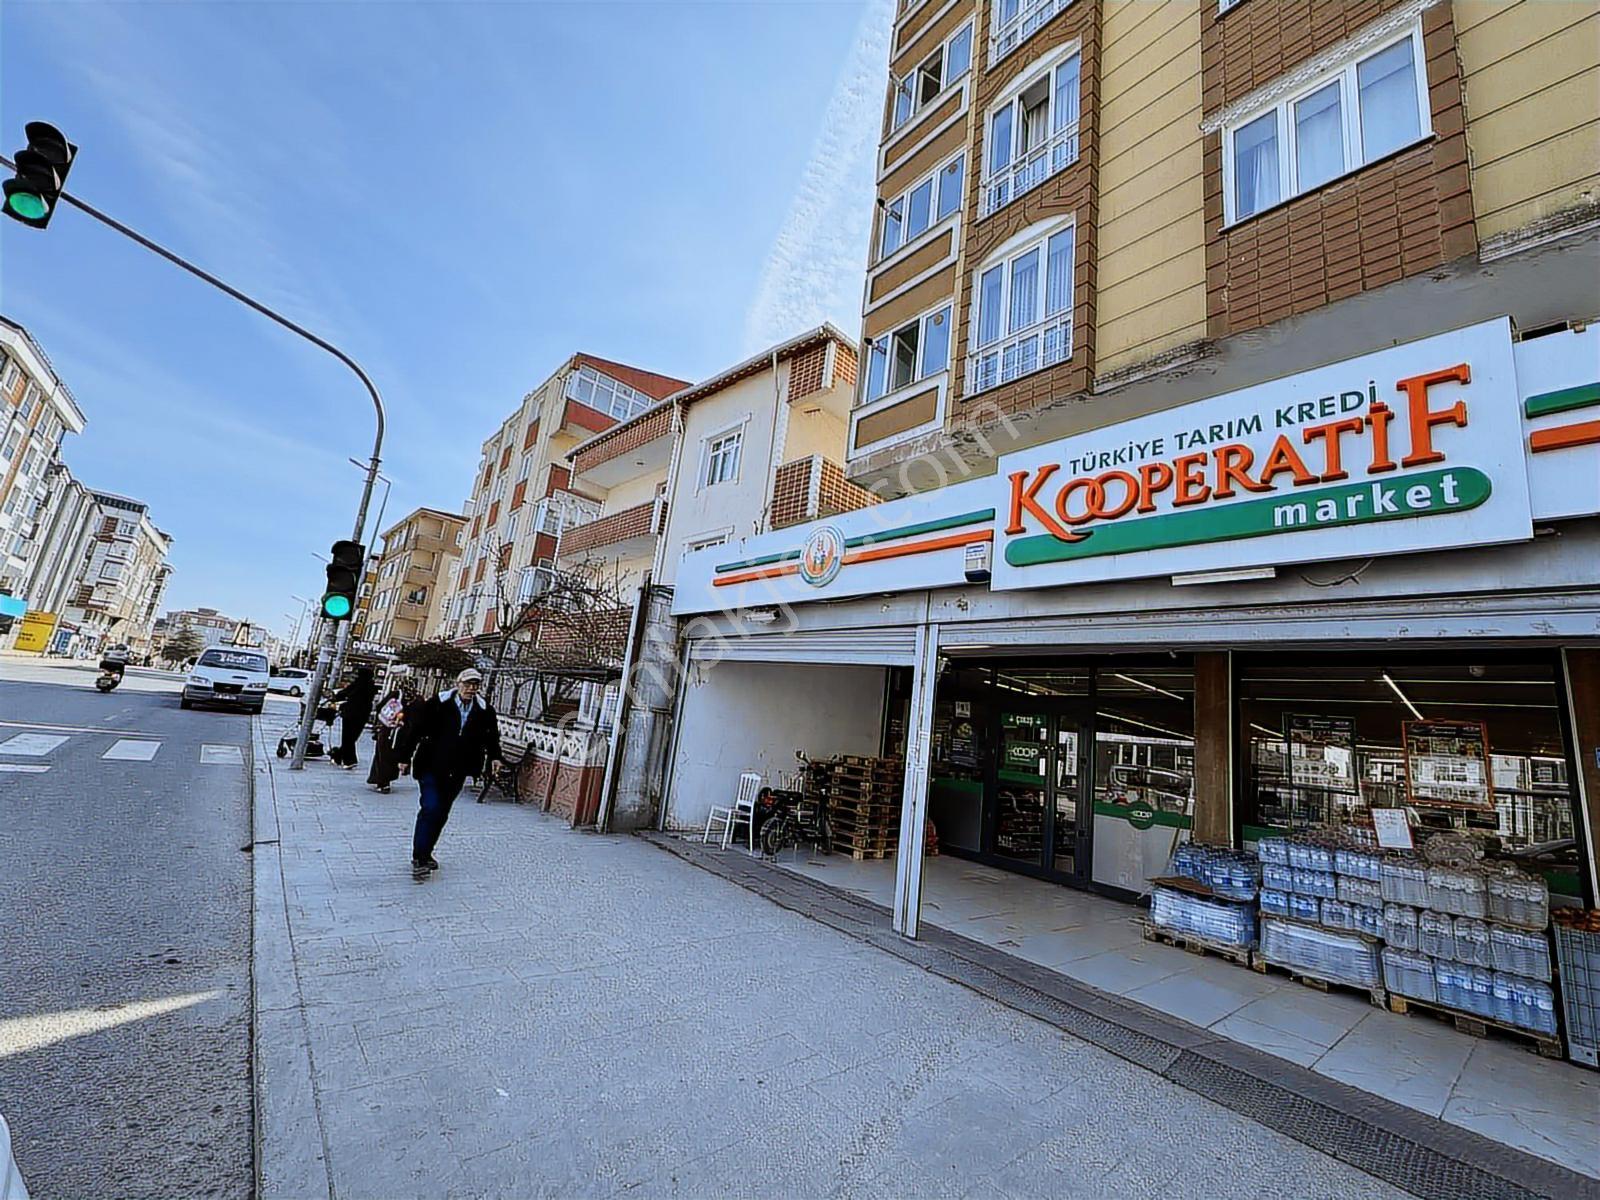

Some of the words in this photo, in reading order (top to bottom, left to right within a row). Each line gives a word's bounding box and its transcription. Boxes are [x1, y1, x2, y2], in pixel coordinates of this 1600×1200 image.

[1004, 364, 1472, 542] KOOPERATİF
[1069, 438, 1164, 475] TÜRKİYE
[1174, 414, 1262, 450] TARIM
[1275, 380, 1378, 428] KREDİ
[1273, 474, 1461, 528] market
[352, 641, 396, 653] DEVRAN
